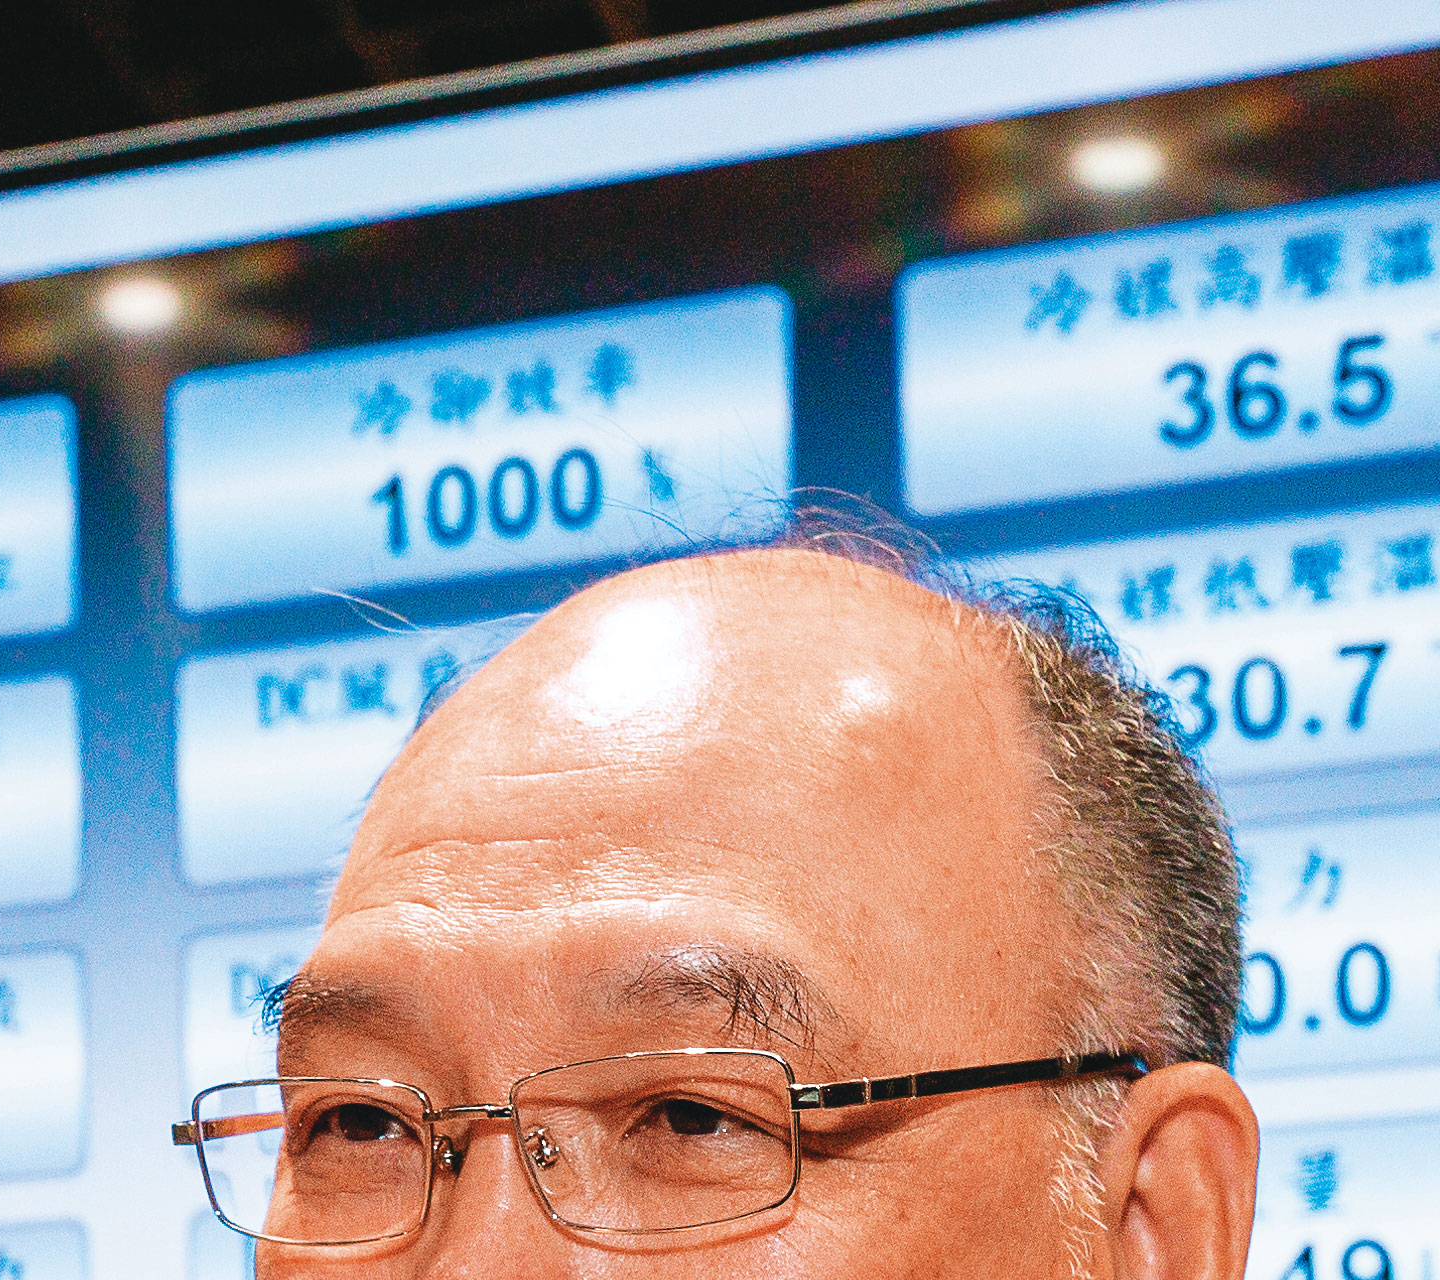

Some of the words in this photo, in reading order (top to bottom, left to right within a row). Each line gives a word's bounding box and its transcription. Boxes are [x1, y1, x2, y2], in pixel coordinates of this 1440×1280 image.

[1158, 333, 1392, 450] 36.5
[368, 447, 604, 556] 1000
[1164, 638, 1390, 748] 30.7
